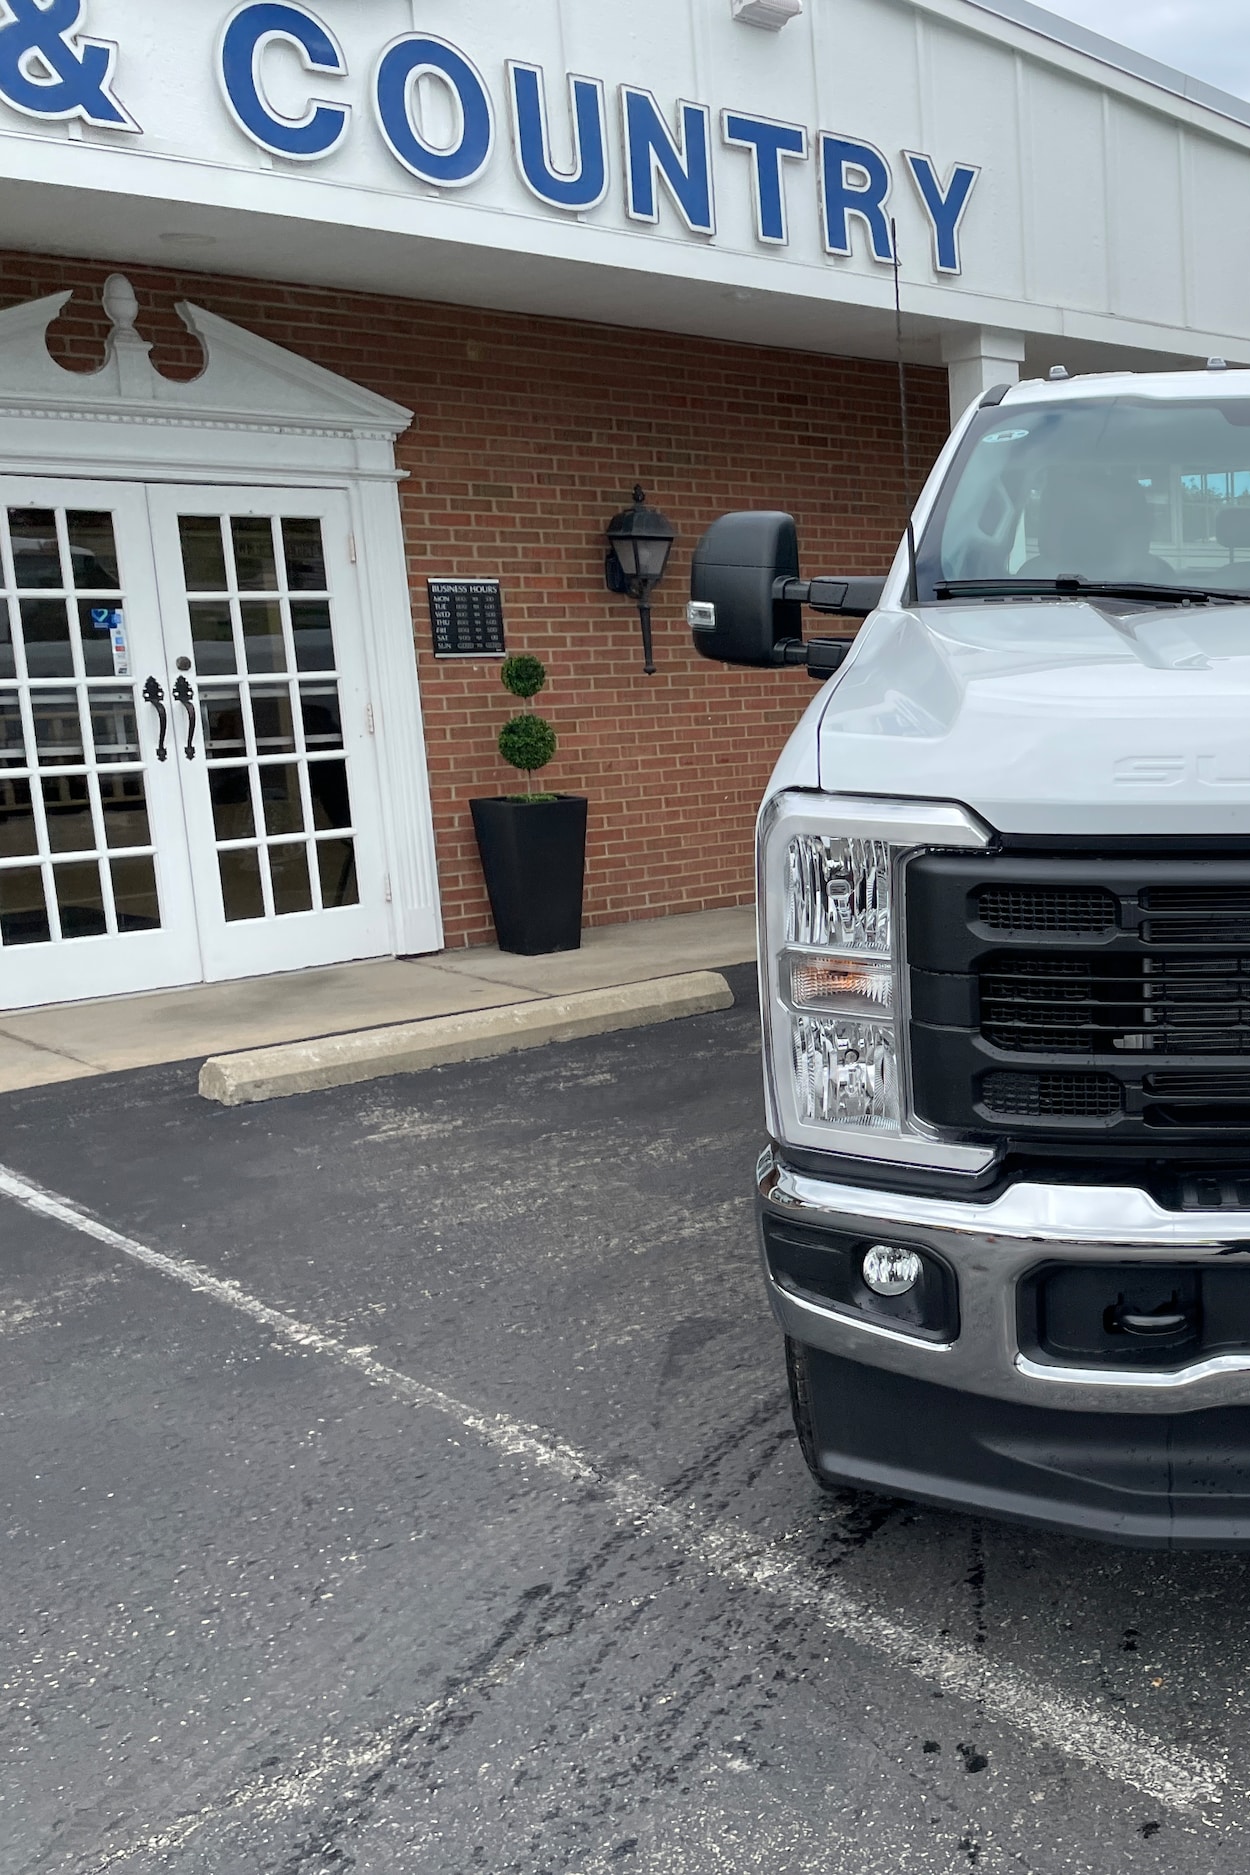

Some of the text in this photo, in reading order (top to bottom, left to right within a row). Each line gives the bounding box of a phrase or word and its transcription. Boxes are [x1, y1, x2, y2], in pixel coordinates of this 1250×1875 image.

[217, 0, 982, 276] COUNTRY
[431, 585, 498, 593] BUSINESS HOURS
